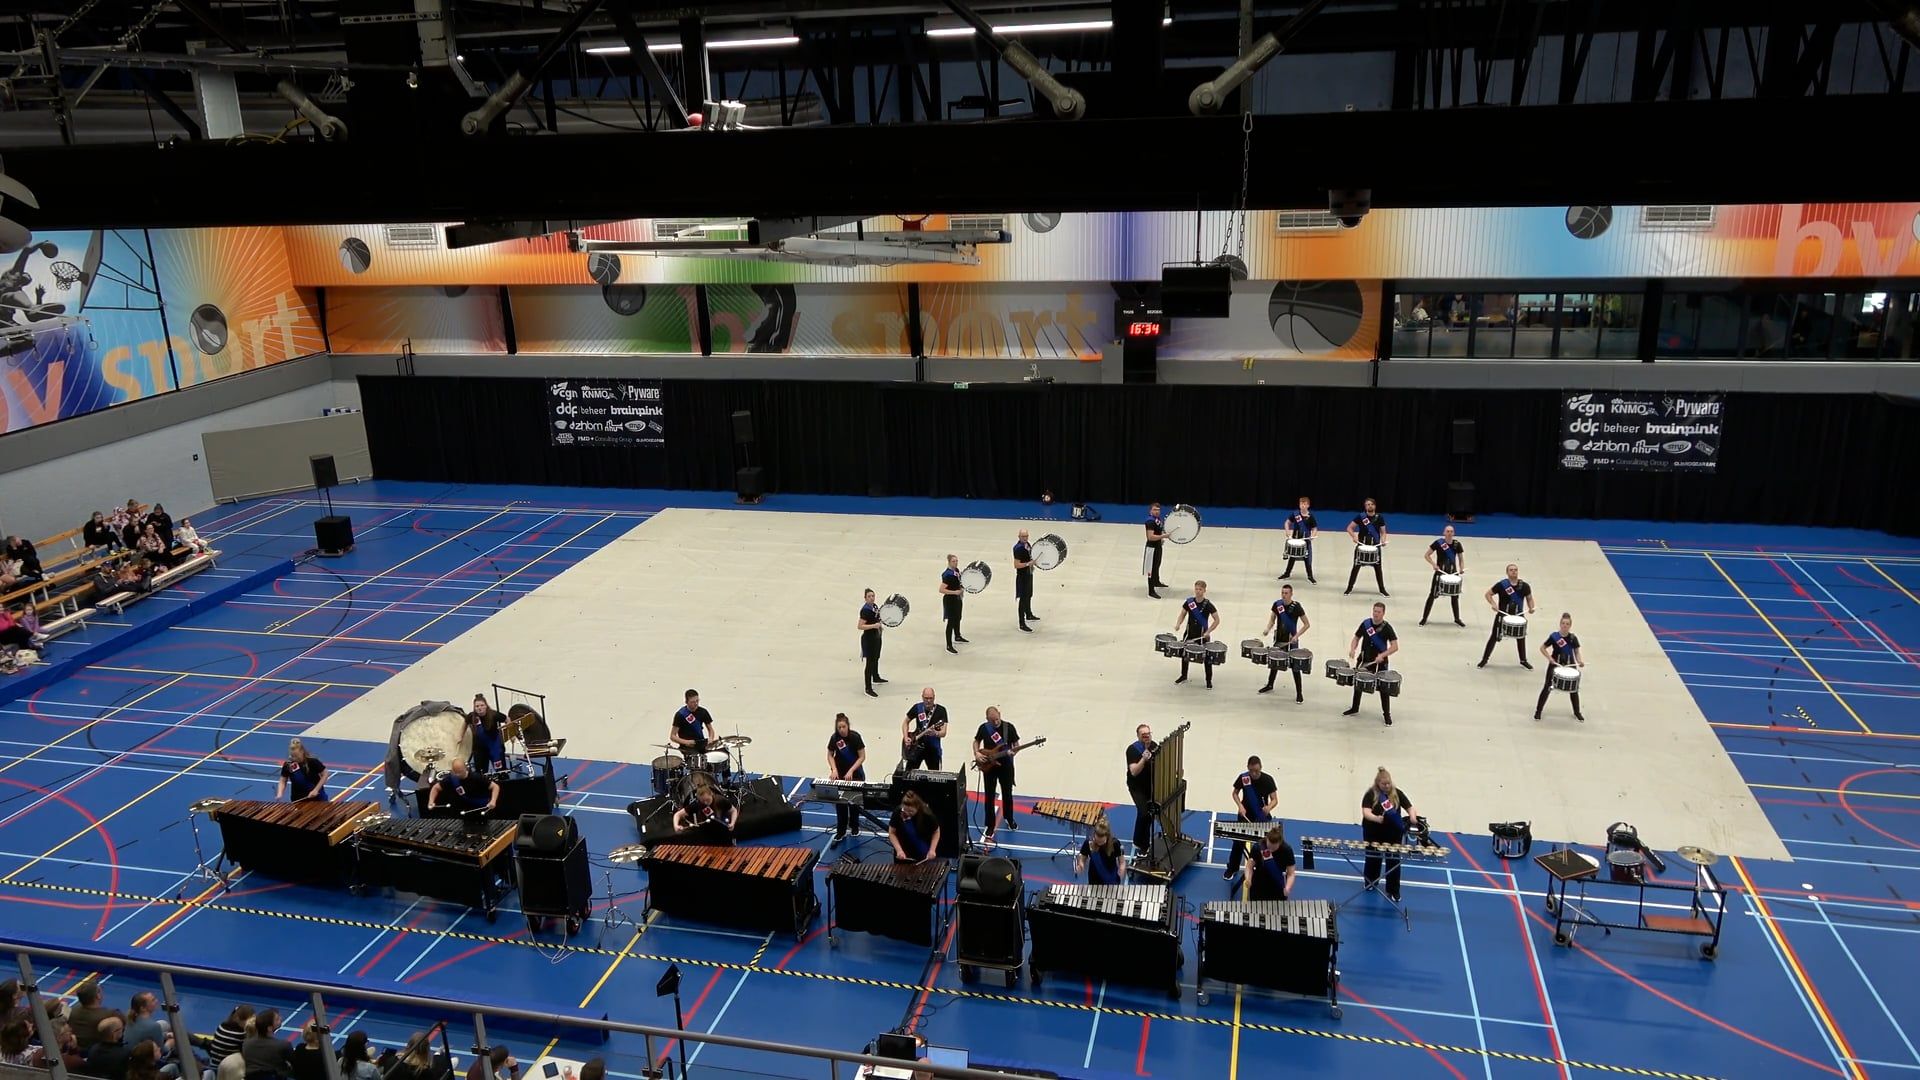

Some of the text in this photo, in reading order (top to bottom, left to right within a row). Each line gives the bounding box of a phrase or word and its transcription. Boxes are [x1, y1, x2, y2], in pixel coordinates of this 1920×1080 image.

[1130, 323, 1159, 335] 16:34
[559, 385, 660, 401] cgn KNMO Pyware
[556, 402, 663, 418] ddf beheer brainpink
[1578, 399, 1719, 417] cgn KNMO Pyware
[1569, 417, 1719, 436] ddf beheer brainpink
